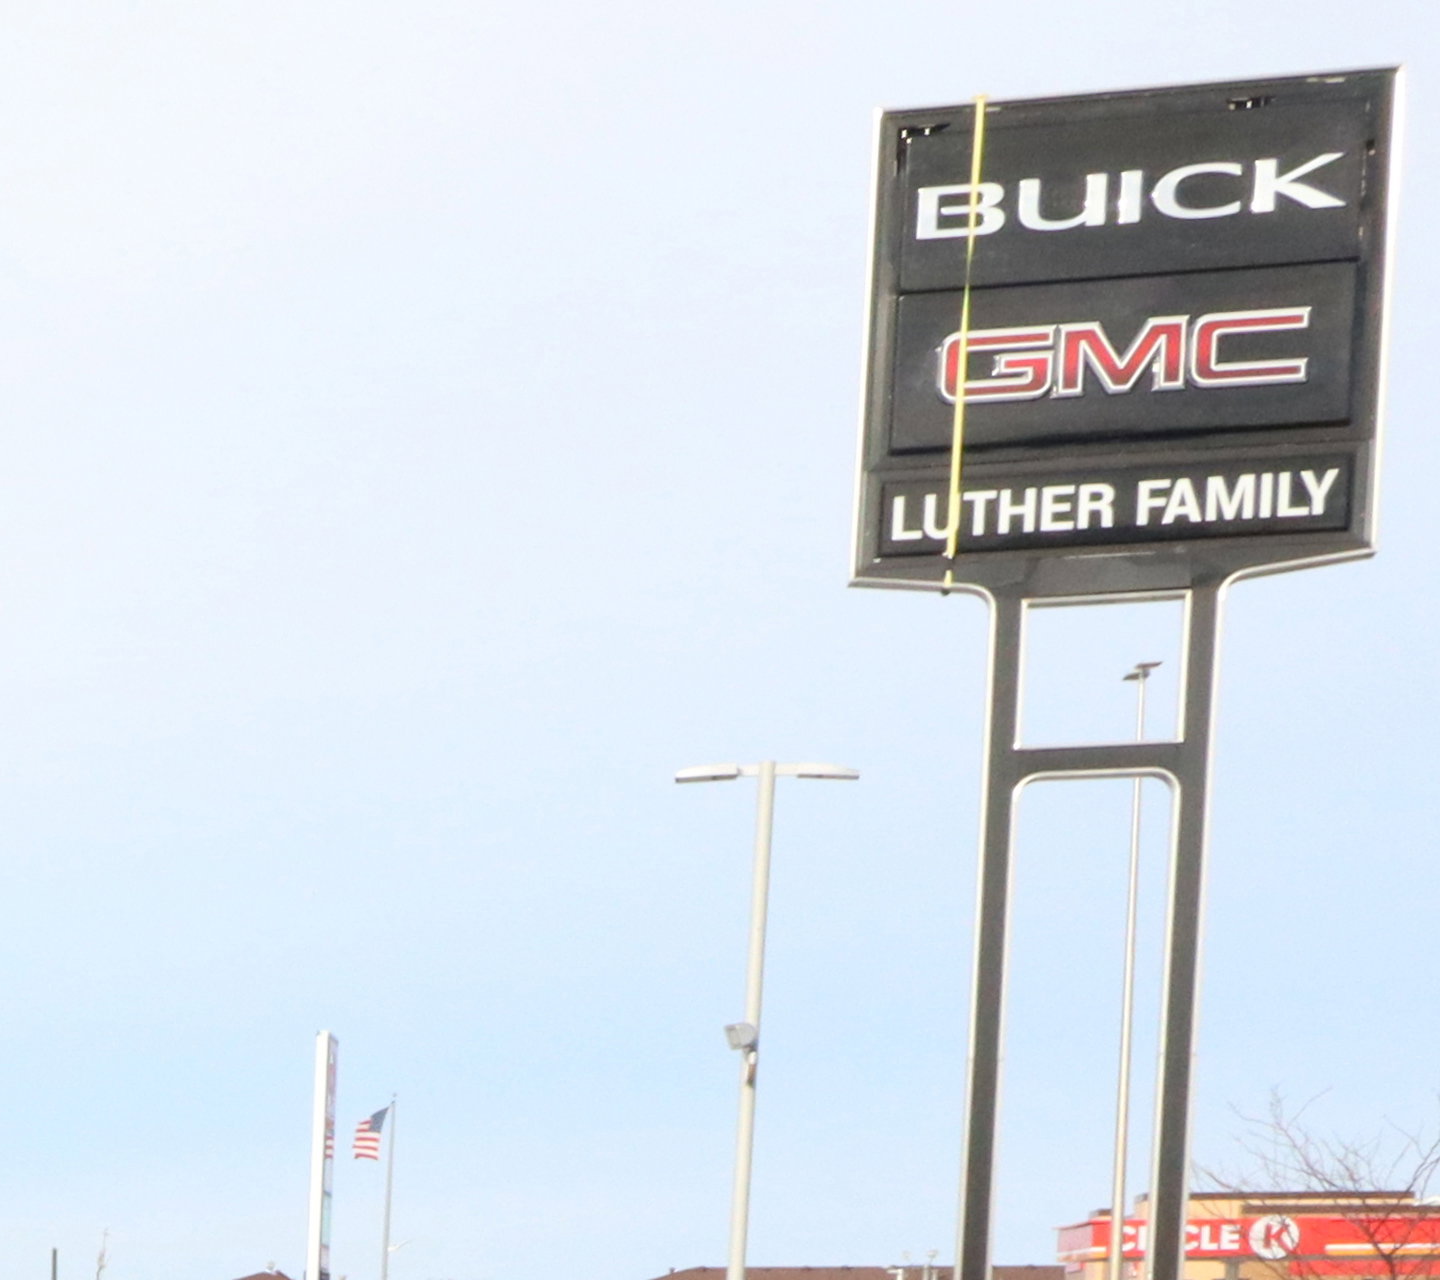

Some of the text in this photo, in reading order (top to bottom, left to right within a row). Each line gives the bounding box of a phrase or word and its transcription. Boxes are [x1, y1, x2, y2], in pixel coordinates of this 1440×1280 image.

[915, 151, 1347, 240] BUICK
[936, 306, 1312, 404] GMC
[891, 469, 1341, 542] LUTHER FAMILY
[1121, 1224, 1242, 1252] CICLE
